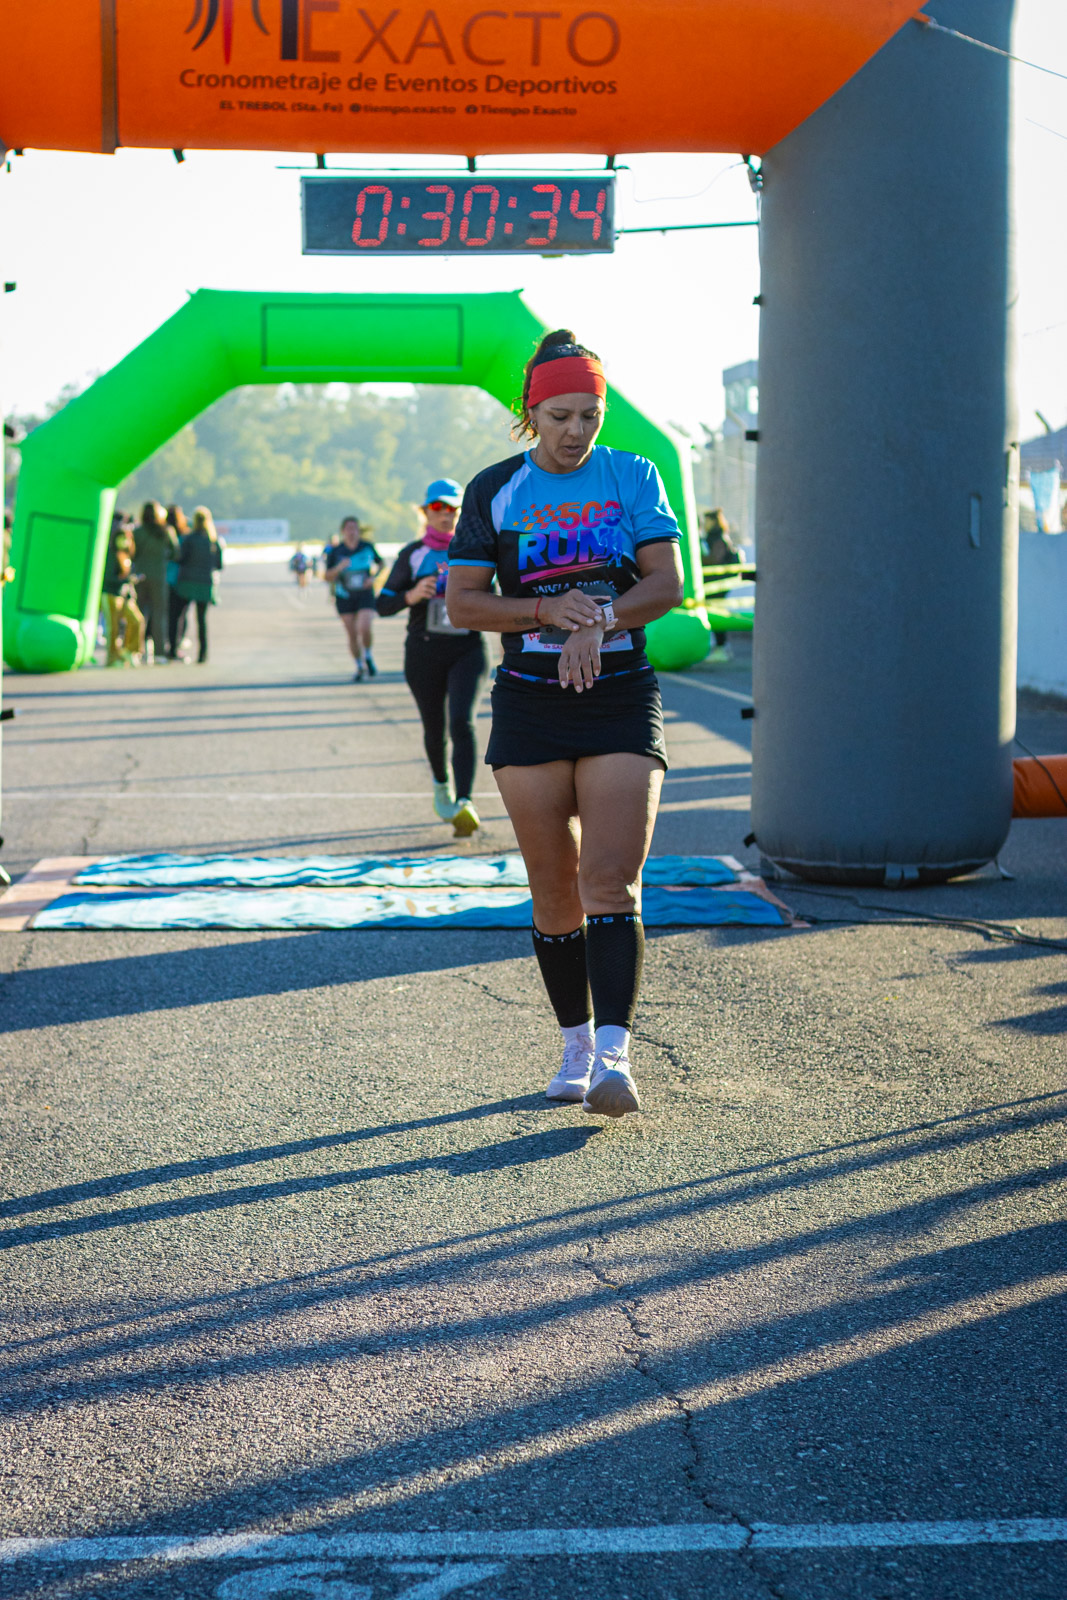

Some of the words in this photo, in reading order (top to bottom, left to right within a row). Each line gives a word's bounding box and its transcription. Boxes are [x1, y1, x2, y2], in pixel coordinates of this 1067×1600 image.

[302, 0, 621, 67] EXACTO
[179, 68, 341, 94] Cronometraje
[347, 72, 378, 92] de
[384, 73, 479, 93] Eventos
[484, 74, 618, 97] Deportivos
[219, 101, 235, 110] EL
[480, 105, 530, 116] Tiempo
[532, 106, 578, 116] Exacto
[351, 184, 606, 247] 0:30:34
[518, 527, 614, 571] RUN
